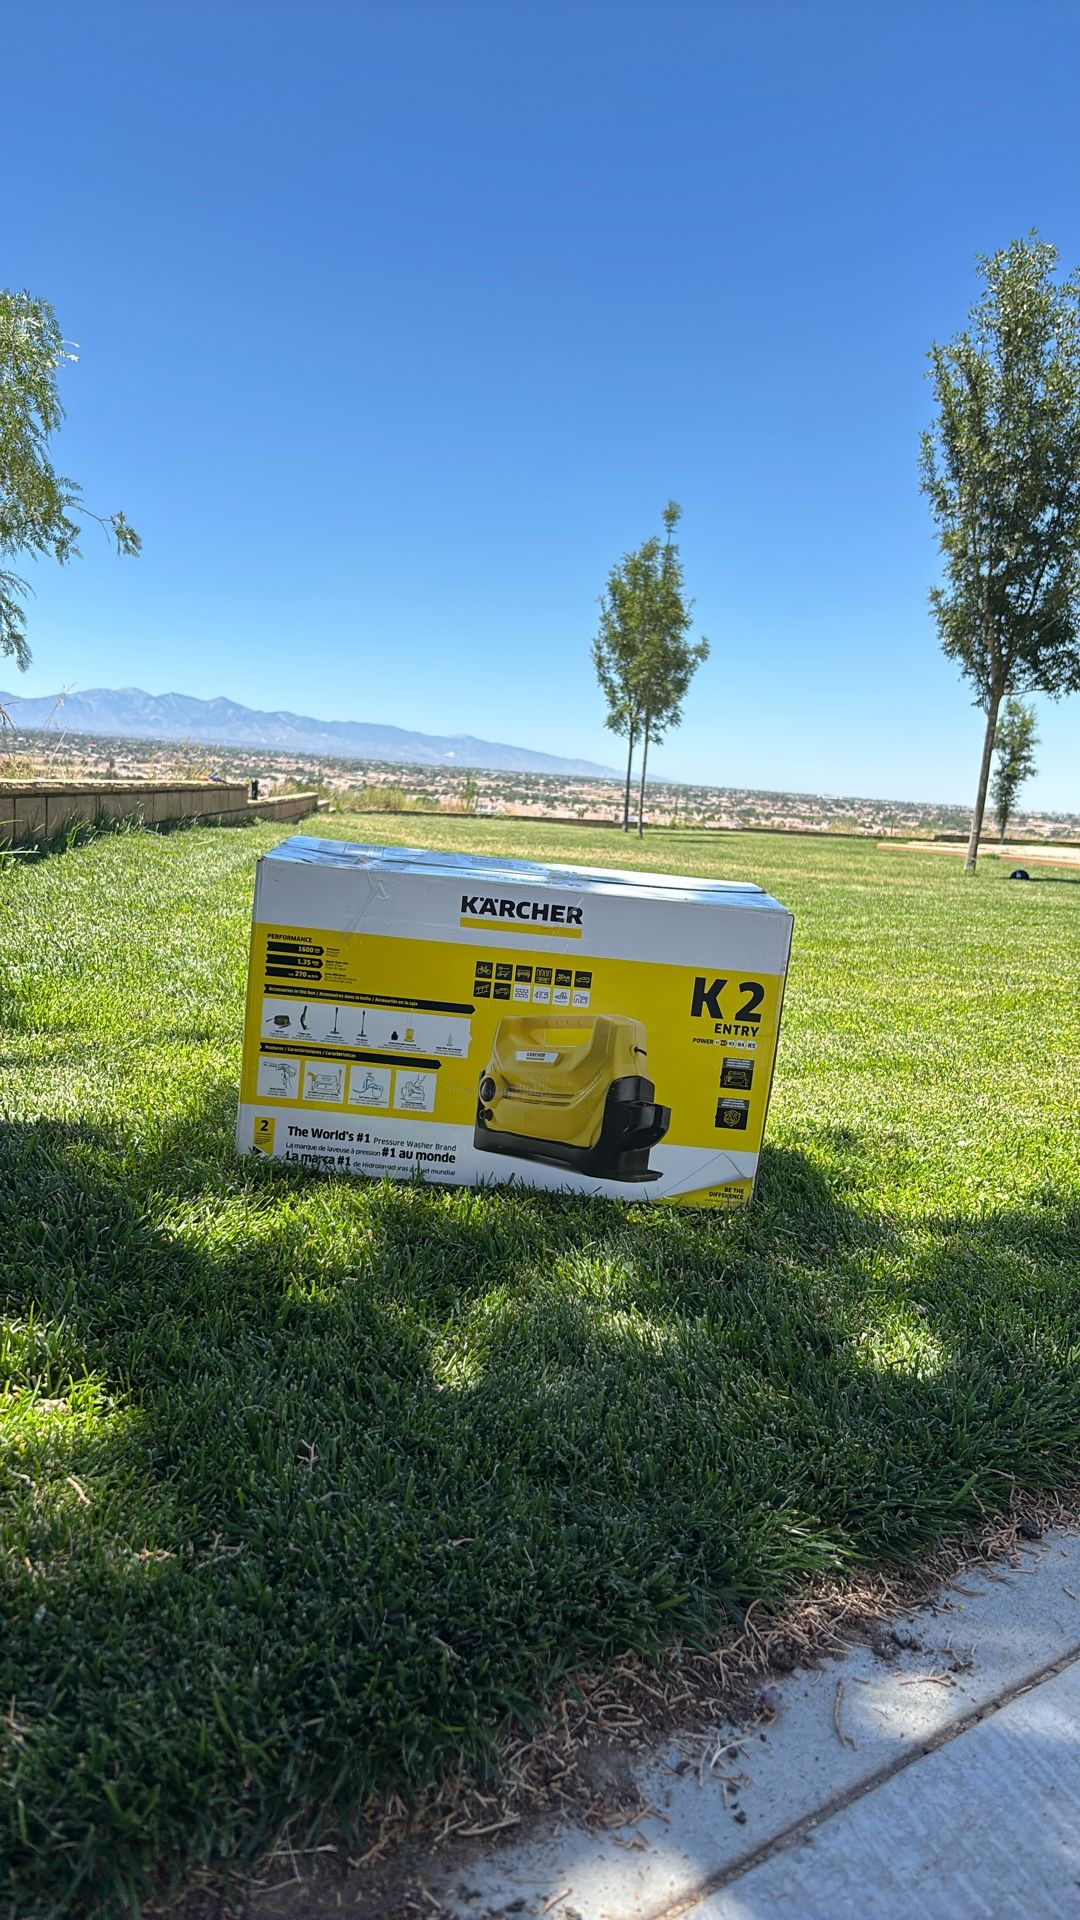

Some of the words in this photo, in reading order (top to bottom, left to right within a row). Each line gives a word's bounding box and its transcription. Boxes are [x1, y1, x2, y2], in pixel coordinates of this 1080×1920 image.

[461, 895, 583, 924] KÄRCHER
[267, 933, 312, 943] PERFORMANCE
[297, 958, 311, 966] 1.35
[294, 970, 307, 978] 270
[714, 1023, 759, 1037] ENTRY
[692, 1037, 714, 1045] POWER
[260, 1120, 269, 1132] 2
[288, 1126, 308, 1137] The
[311, 1128, 354, 1142] World's
[356, 1133, 370, 1143] #1
[373, 1137, 404, 1147] Pressure
[406, 1140, 433, 1150] Washer
[435, 1143, 457, 1152] Brand
[327, 1146, 350, 1154] laveuse
[355, 1148, 381, 1158] pression
[382, 1146, 396, 1158] #1
[399, 1149, 413, 1159] au
[416, 1152, 456, 1163] monde
[286, 1151, 299, 1161] La
[337, 1156, 351, 1167] #1
[430, 1168, 456, 1176] mundial
